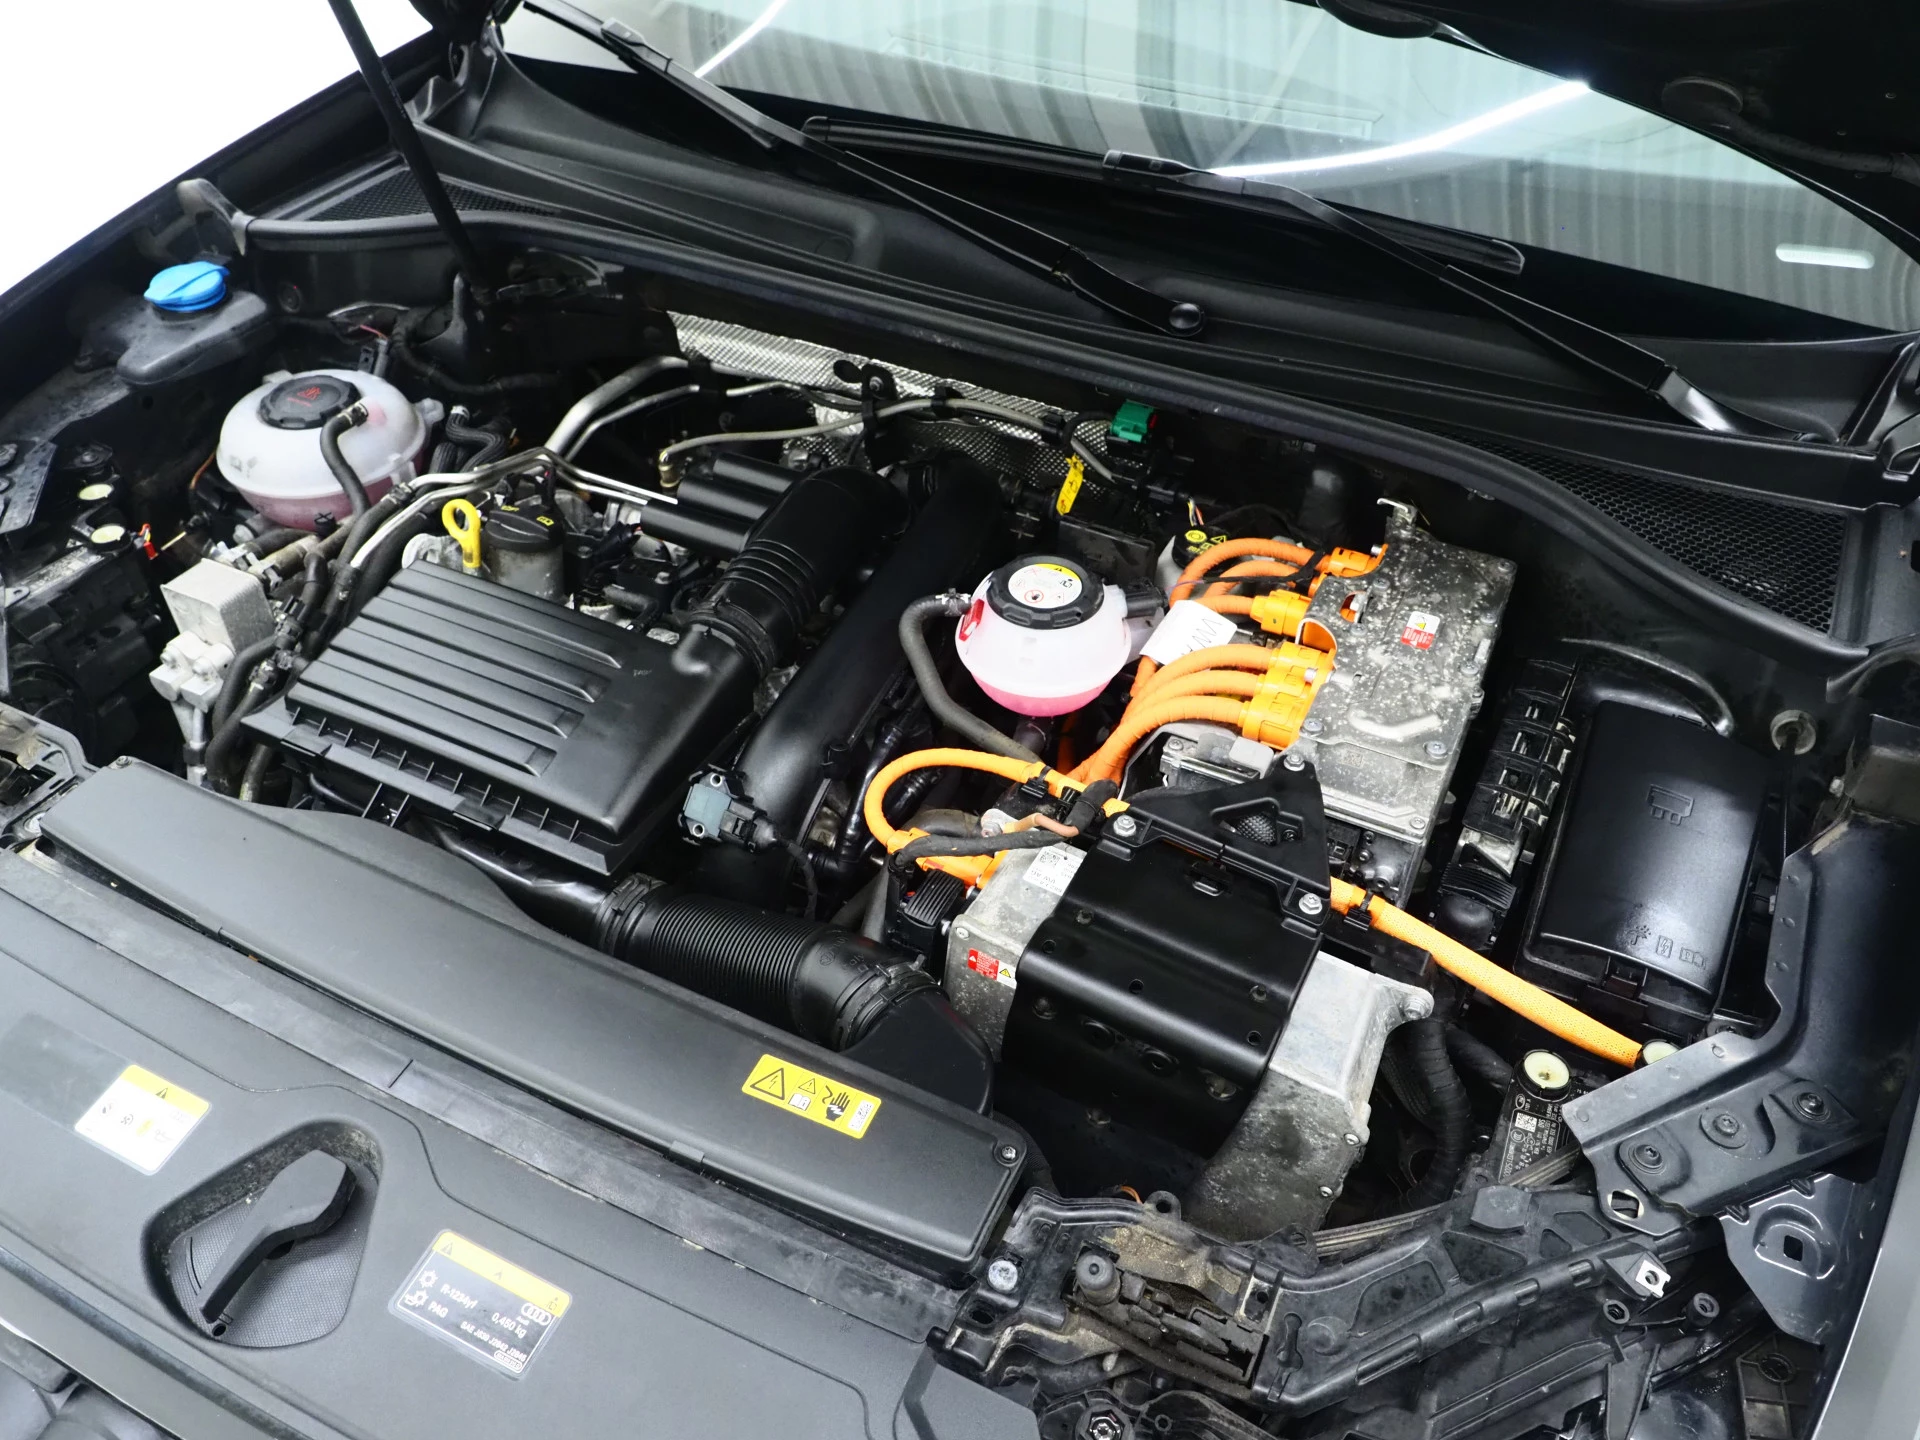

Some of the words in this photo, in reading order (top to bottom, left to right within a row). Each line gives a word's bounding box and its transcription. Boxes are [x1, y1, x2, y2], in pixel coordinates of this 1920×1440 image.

[427, 1301, 449, 1319] PAG
[460, 1321, 476, 1334] SAE
[491, 1312, 515, 1331] 0,450
[514, 1324, 527, 1339] kg
